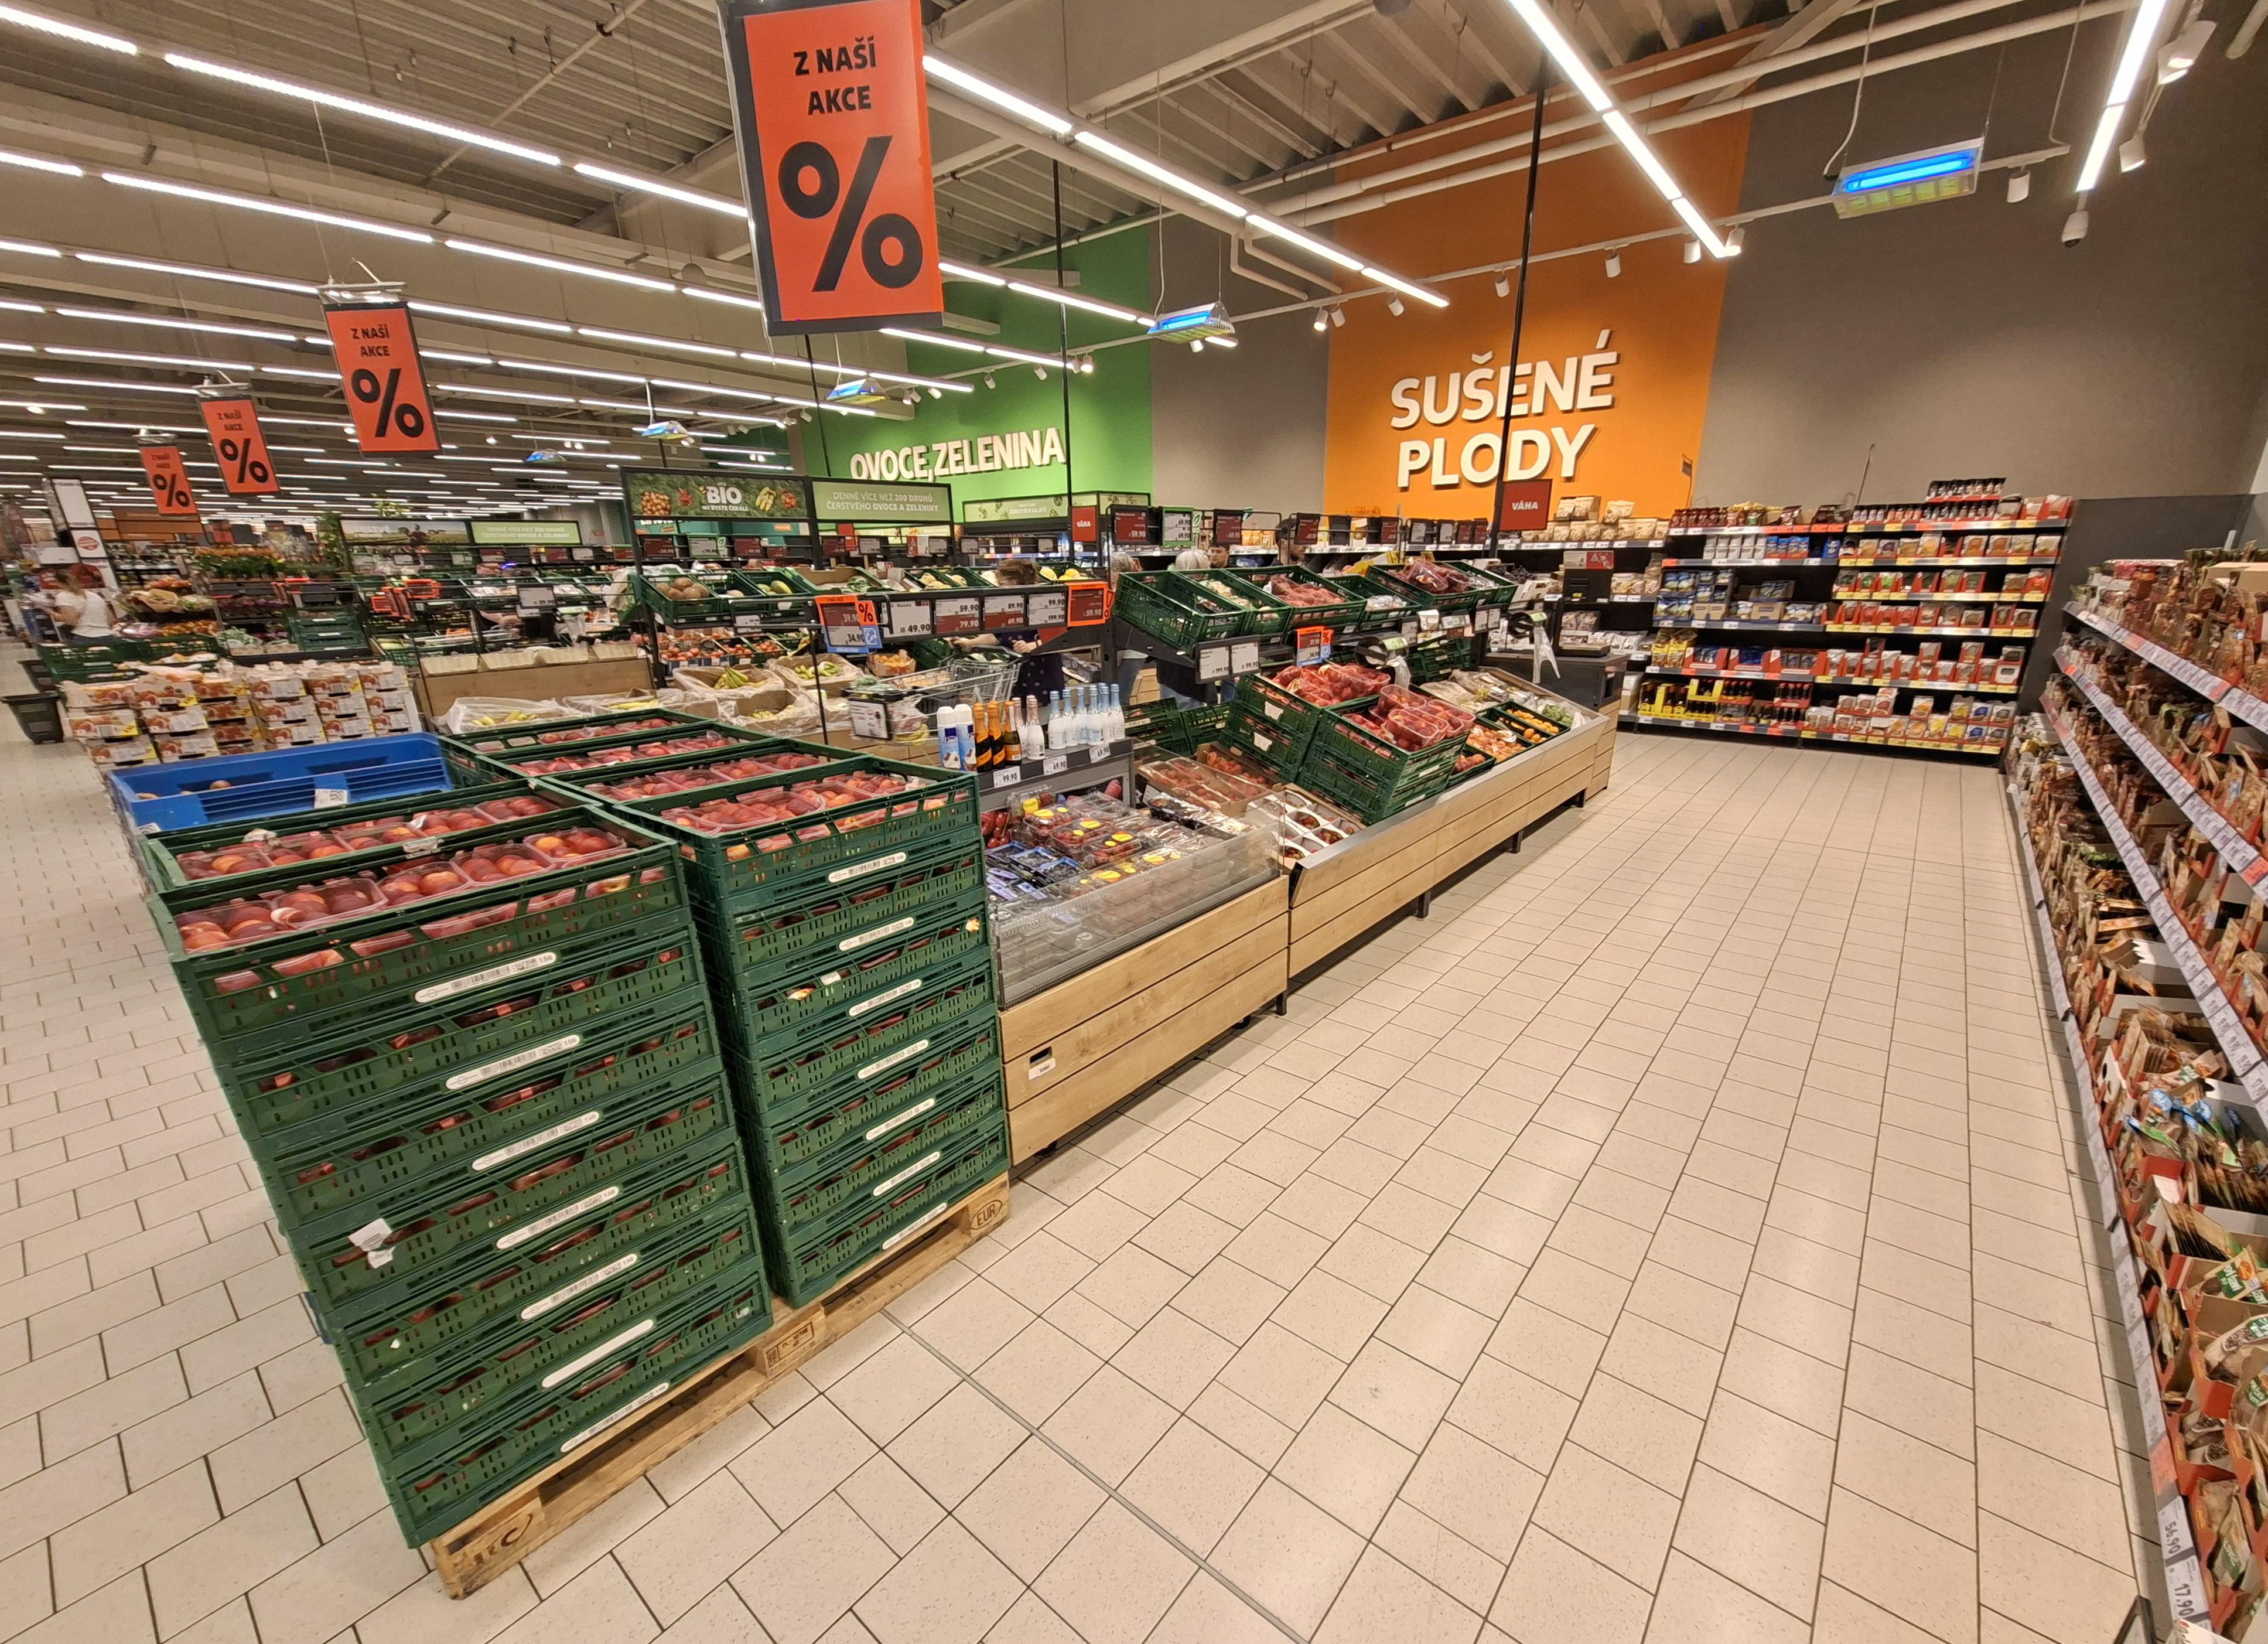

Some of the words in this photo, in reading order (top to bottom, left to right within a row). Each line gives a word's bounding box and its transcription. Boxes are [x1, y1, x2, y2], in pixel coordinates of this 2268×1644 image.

[793, 50, 809, 76] Z
[816, 35, 877, 73] NAŠÍ
[808, 85, 872, 115] AKCE
[778, 135, 923, 292] %
[350, 328, 359, 339] Z
[361, 323, 391, 339] NAŠÍ
[360, 345, 390, 357] AKCE
[1390, 329, 1618, 428] SUŠENÉ
[351, 368, 424, 438] %
[932, 427, 1066, 476] ZELENINA
[1398, 424, 1596, 487] PLODY
[706, 486, 742, 504] BIO
[832, 491, 859, 500] DENNĚ
[860, 491, 877, 501] VÍCE
[879, 492, 893, 501] NEŽ
[909, 494, 933, 502] DRUHŮ
[826, 500, 871, 510] ČERSTVÉHO
[1512, 500, 1538, 510] VÁHA
[1077, 519, 1091, 528] VÁHA
[959, 604, 979, 612] 59.90
[1086, 609, 1101, 617] 59.90
[907, 623, 930, 633] 49.90
[959, 619, 979, 629] 79.90
[1002, 773, 1017, 783] 99.90
[539, 955, 552, 964] 156
[563, 1038, 577, 1046] 156
[976, 1203, 995, 1227] EUR
[2164, 1520, 2181, 1554] 56.90
[2174, 1583, 2195, 1616] 17.90
